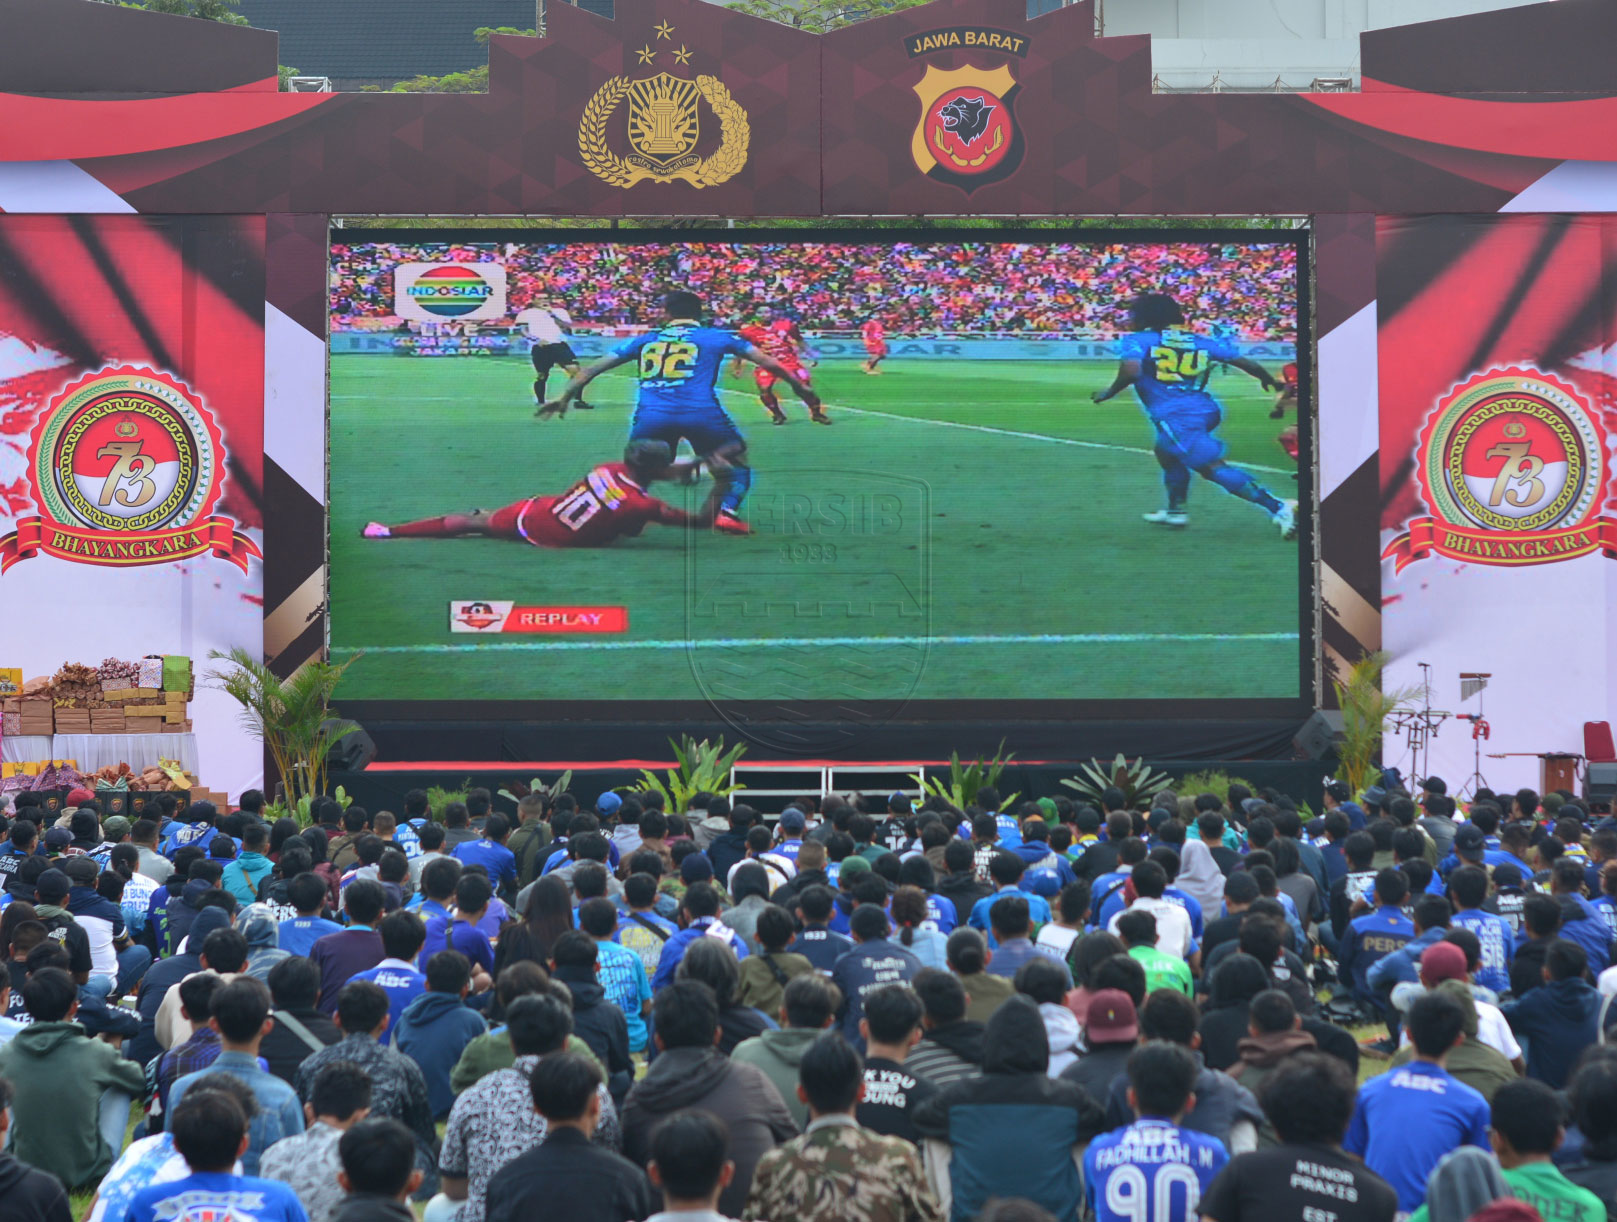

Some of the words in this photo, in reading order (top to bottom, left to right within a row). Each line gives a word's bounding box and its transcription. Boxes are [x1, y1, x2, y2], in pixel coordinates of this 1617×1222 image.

[914, 32, 961, 53] JAWA
[965, 31, 1024, 52] BARAT
[407, 286, 495, 296] INDOSIAR
[420, 322, 479, 336] LIVE
[97, 439, 156, 507] 73
[1486, 440, 1545, 507] 73
[51, 532, 202, 558] BHAYANGKARA
[1444, 532, 1592, 558] BHAYANGKARA
[520, 613, 604, 626] REPLAY
[1364, 936, 1406, 952] PERS
[880, 1069, 916, 1089] YOU
[1296, 1160, 1355, 1186] MINOR
[1106, 1163, 1200, 1222] 90
[1290, 1173, 1358, 1203] PRAXIS
